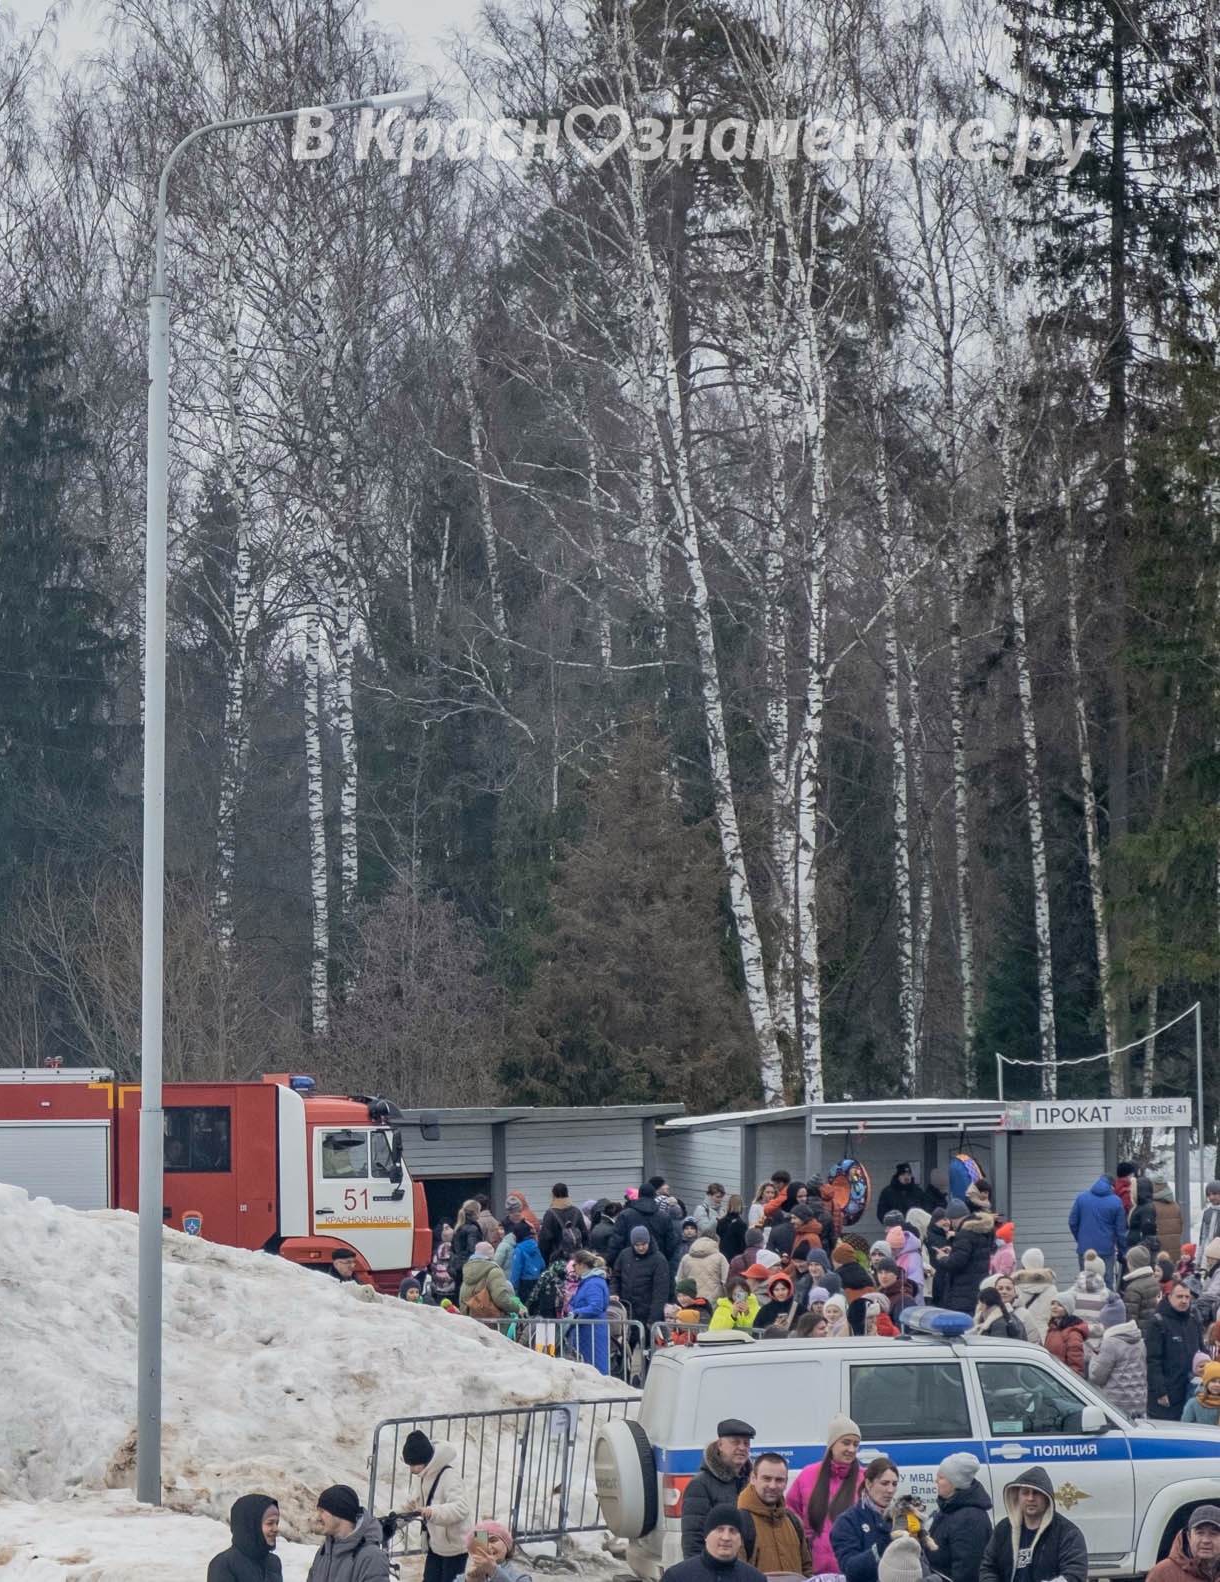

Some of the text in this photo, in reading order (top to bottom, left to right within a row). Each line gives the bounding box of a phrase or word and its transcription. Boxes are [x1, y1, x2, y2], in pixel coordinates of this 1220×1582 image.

[1036, 1106, 1112, 1123] ПРОКАТ
[1124, 1104, 1187, 1115] JUST RIDE 41
[344, 1188, 369, 1211] 51
[325, 1215, 410, 1224] КРАСНОЗНАМЕНСК
[1033, 1444, 1098, 1457] ПОЛИЦИЯ
[909, 1473, 934, 1483] МВД
[911, 1486, 937, 1495] Влас
